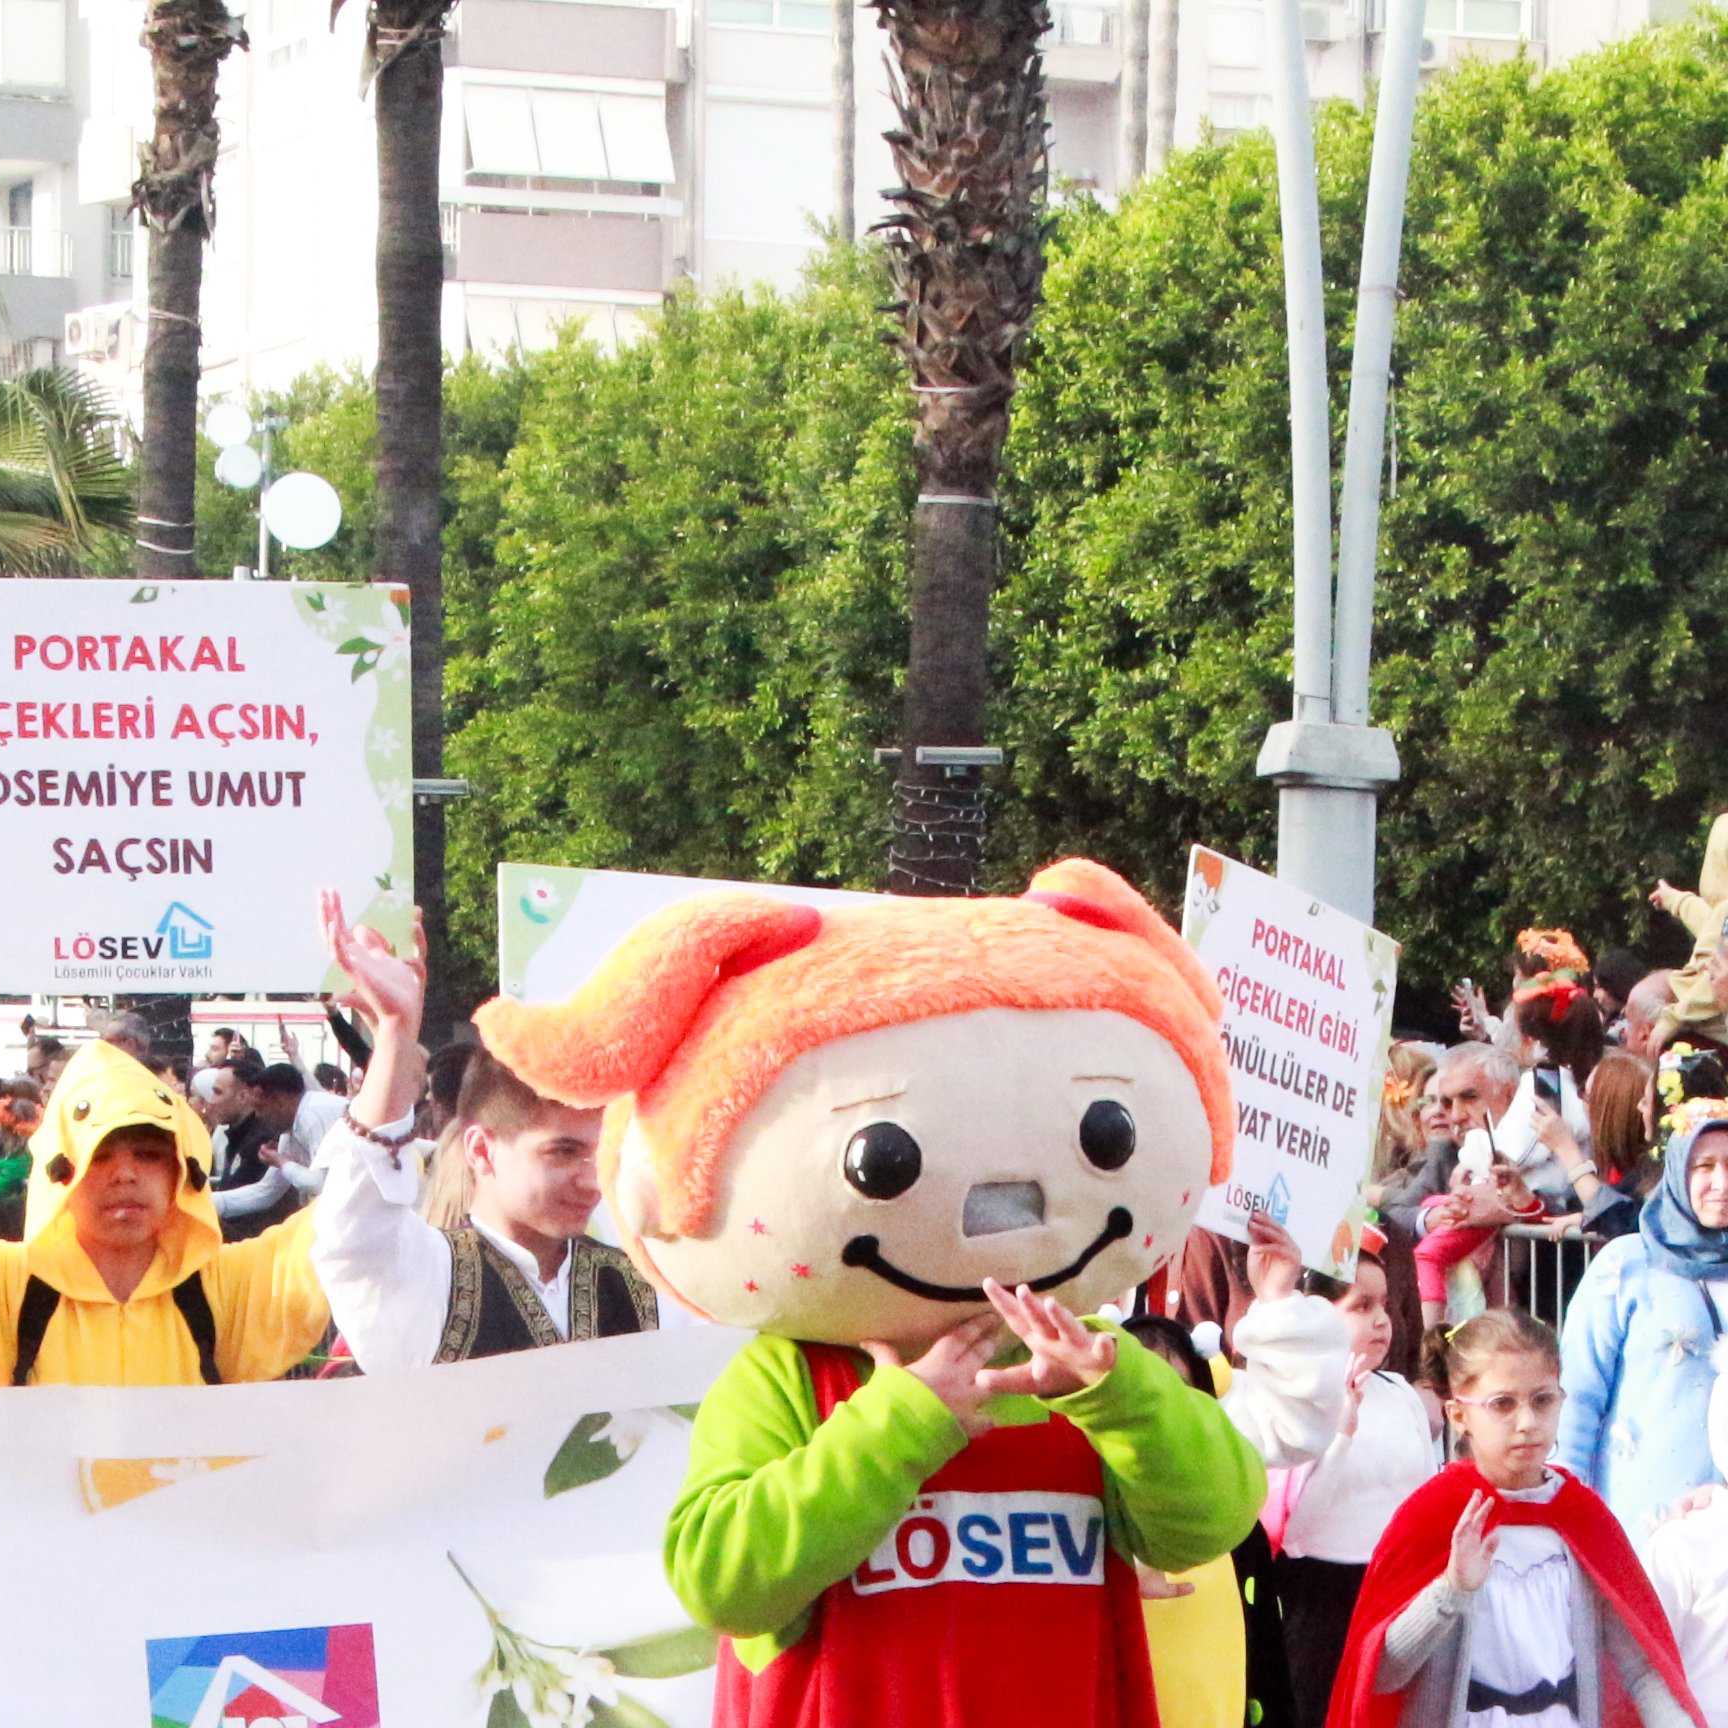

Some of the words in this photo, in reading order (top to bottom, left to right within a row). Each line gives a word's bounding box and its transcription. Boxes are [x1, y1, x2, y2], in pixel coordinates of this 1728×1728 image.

[14, 634, 245, 672] PORTAKAL
[171, 702, 319, 746] AÇSIN,
[189, 771, 306, 807] UMUT
[53, 837, 213, 881] SAÇSIN
[54, 932, 164, 960] LÖSEV
[1251, 918, 1346, 991] PORTAKAL
[54, 966, 112, 979] Lösemili
[116, 965, 175, 981] Çocuklar
[179, 965, 213, 979] Vakfı
[1319, 1010, 1359, 1063] GİBİ,
[1332, 1080, 1357, 1118] DE
[1276, 1125, 1331, 1169] VERİR
